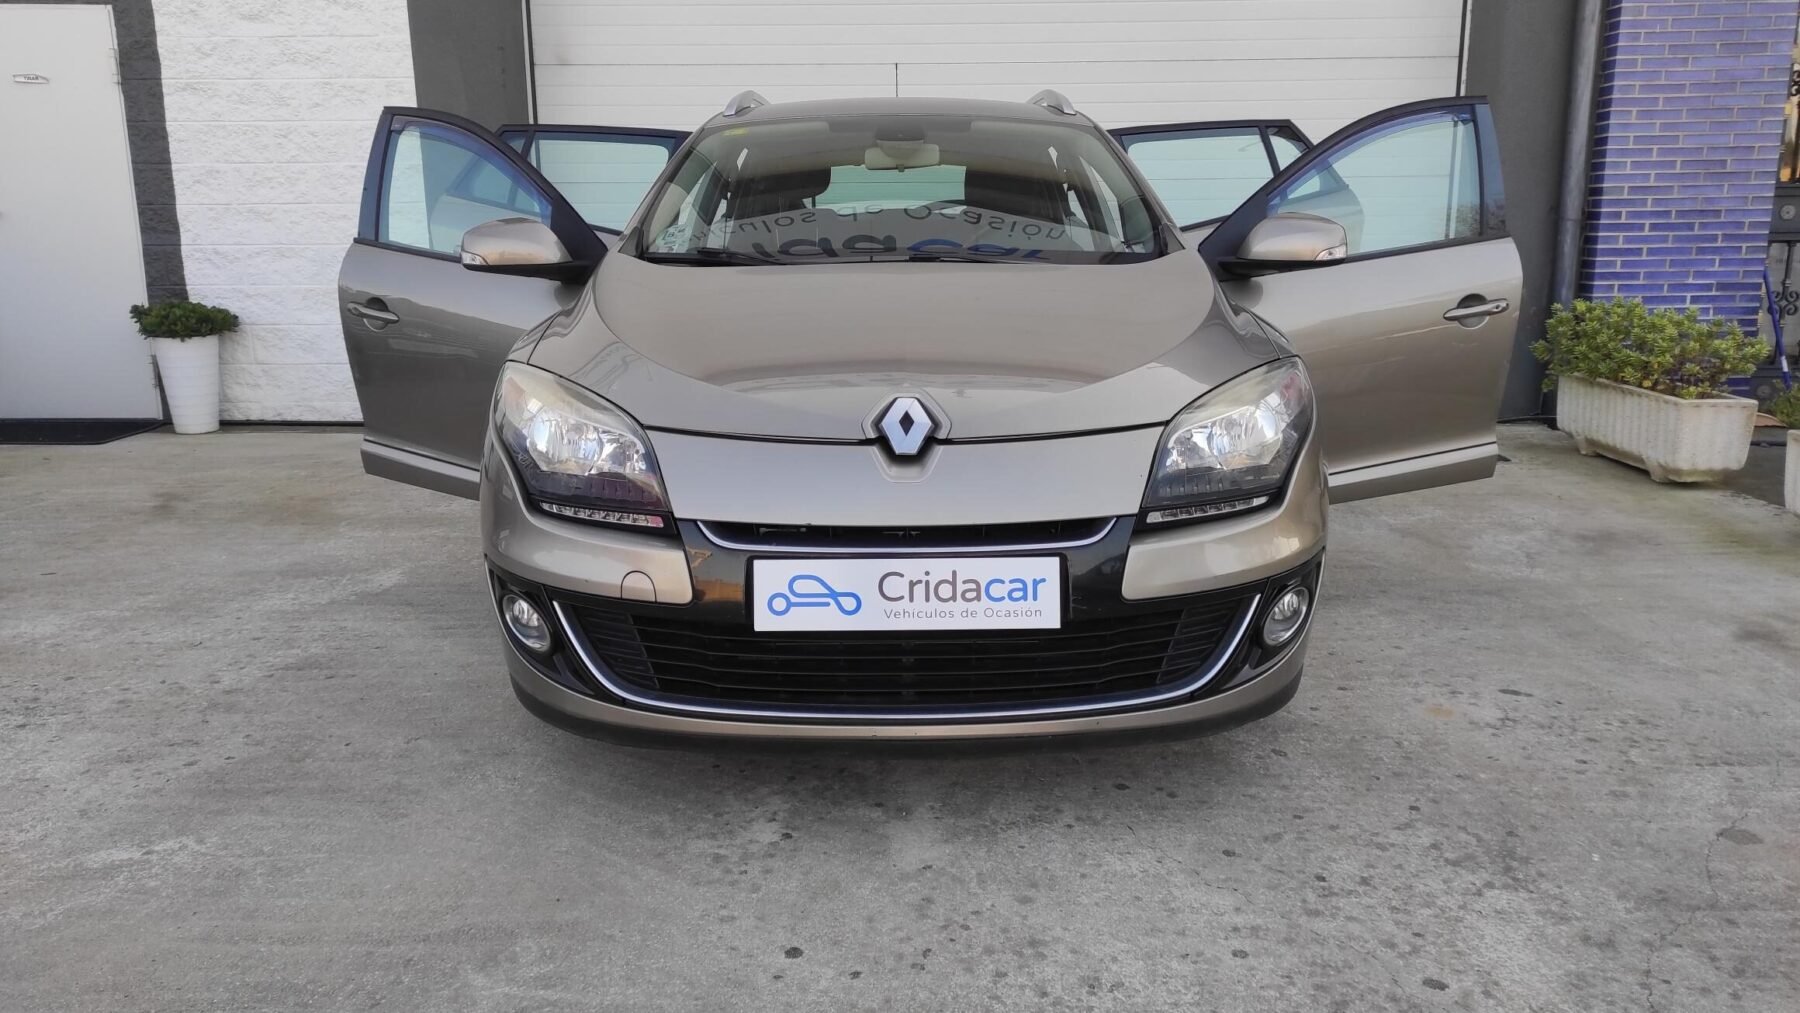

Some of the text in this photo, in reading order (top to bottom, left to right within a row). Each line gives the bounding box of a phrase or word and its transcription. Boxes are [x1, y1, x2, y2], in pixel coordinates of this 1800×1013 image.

[878, 570, 1047, 603] Cridacar
[883, 607, 1042, 619] Vehículos de Ocasión
